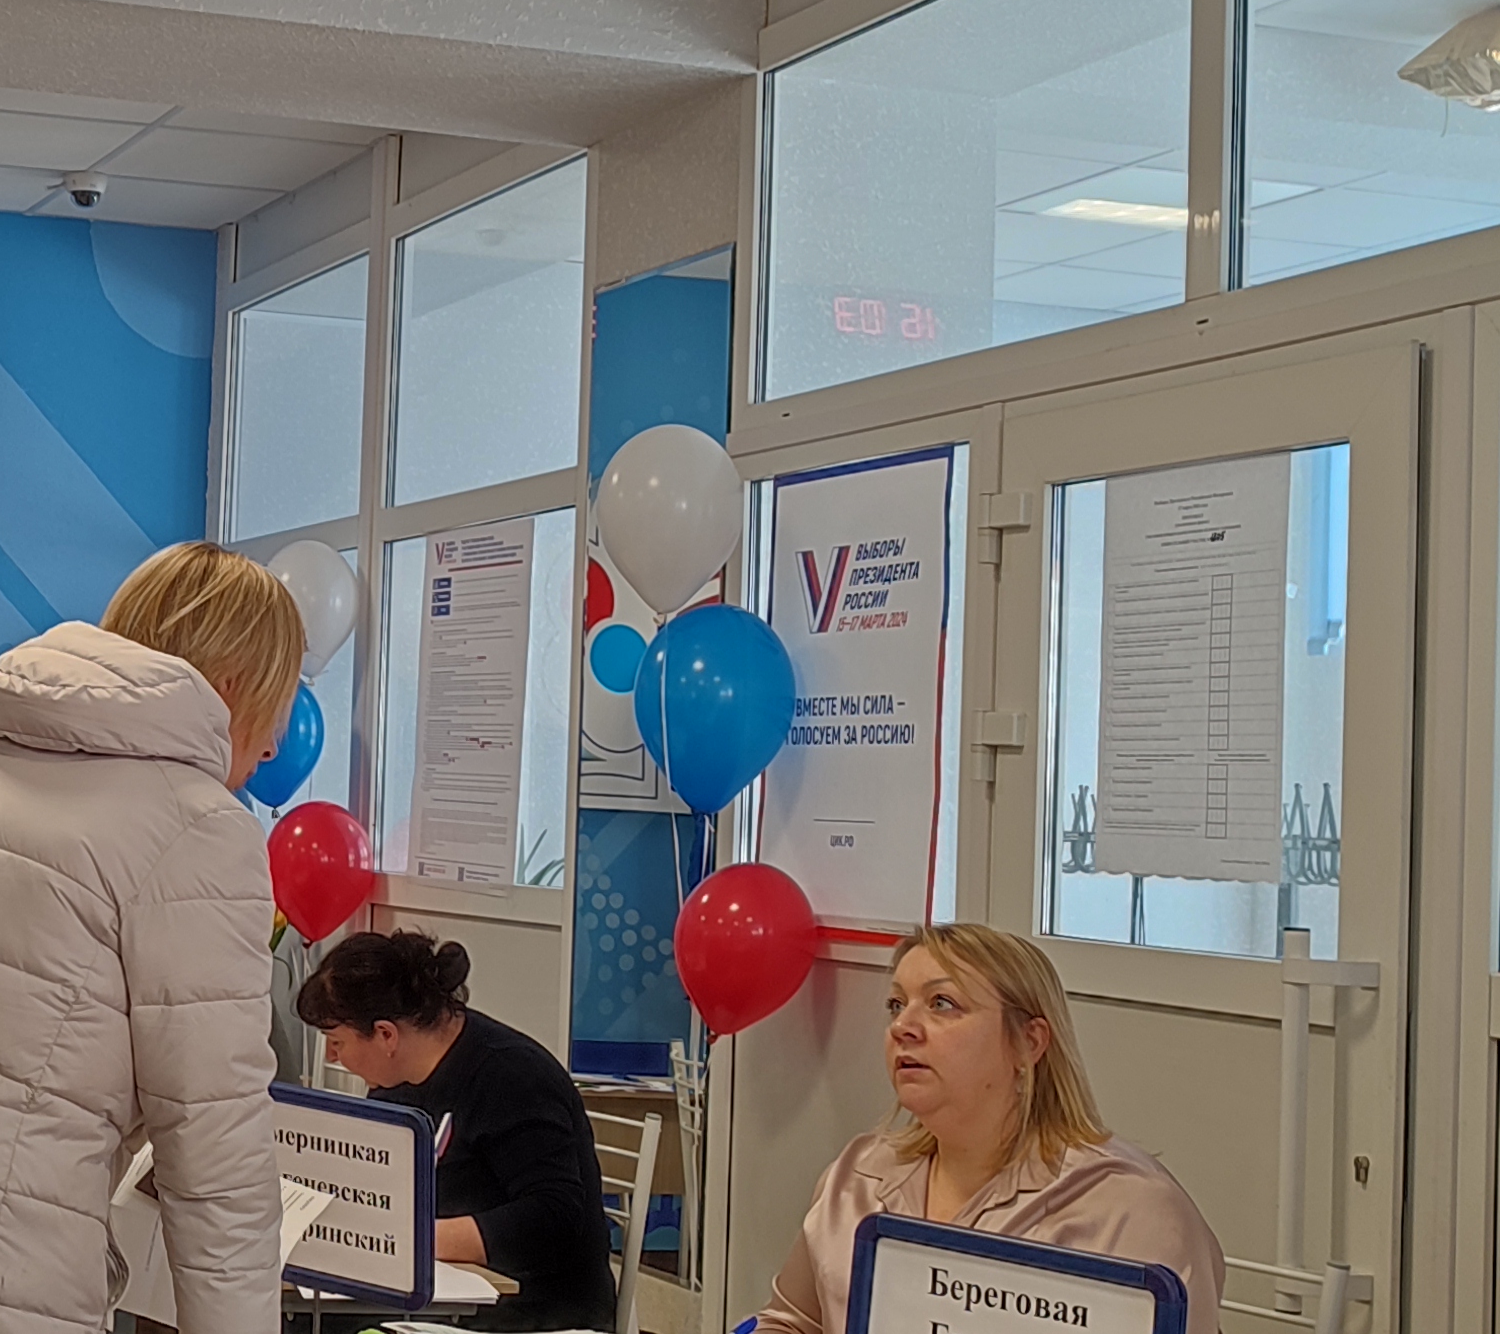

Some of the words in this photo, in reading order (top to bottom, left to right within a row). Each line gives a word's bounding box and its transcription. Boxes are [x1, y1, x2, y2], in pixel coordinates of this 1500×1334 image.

[854, 537, 907, 562] ВЫБОРЫ
[848, 560, 922, 587] ПРЕЗИДЕНТА
[842, 588, 890, 612] РОССИИ
[858, 614, 887, 632] МАРТА
[886, 611, 910, 629] 2024
[795, 696, 838, 718] ВМЕСТЕ
[839, 695, 861, 717] МЫ
[862, 694, 895, 716] СИЛА
[843, 724, 858, 745] ЗА
[860, 723, 916, 746] РОССИЮ!
[273, 1128, 391, 1167] мерницкая
[301, 1223, 397, 1257] ринский
[926, 1266, 1089, 1329] Береговая
